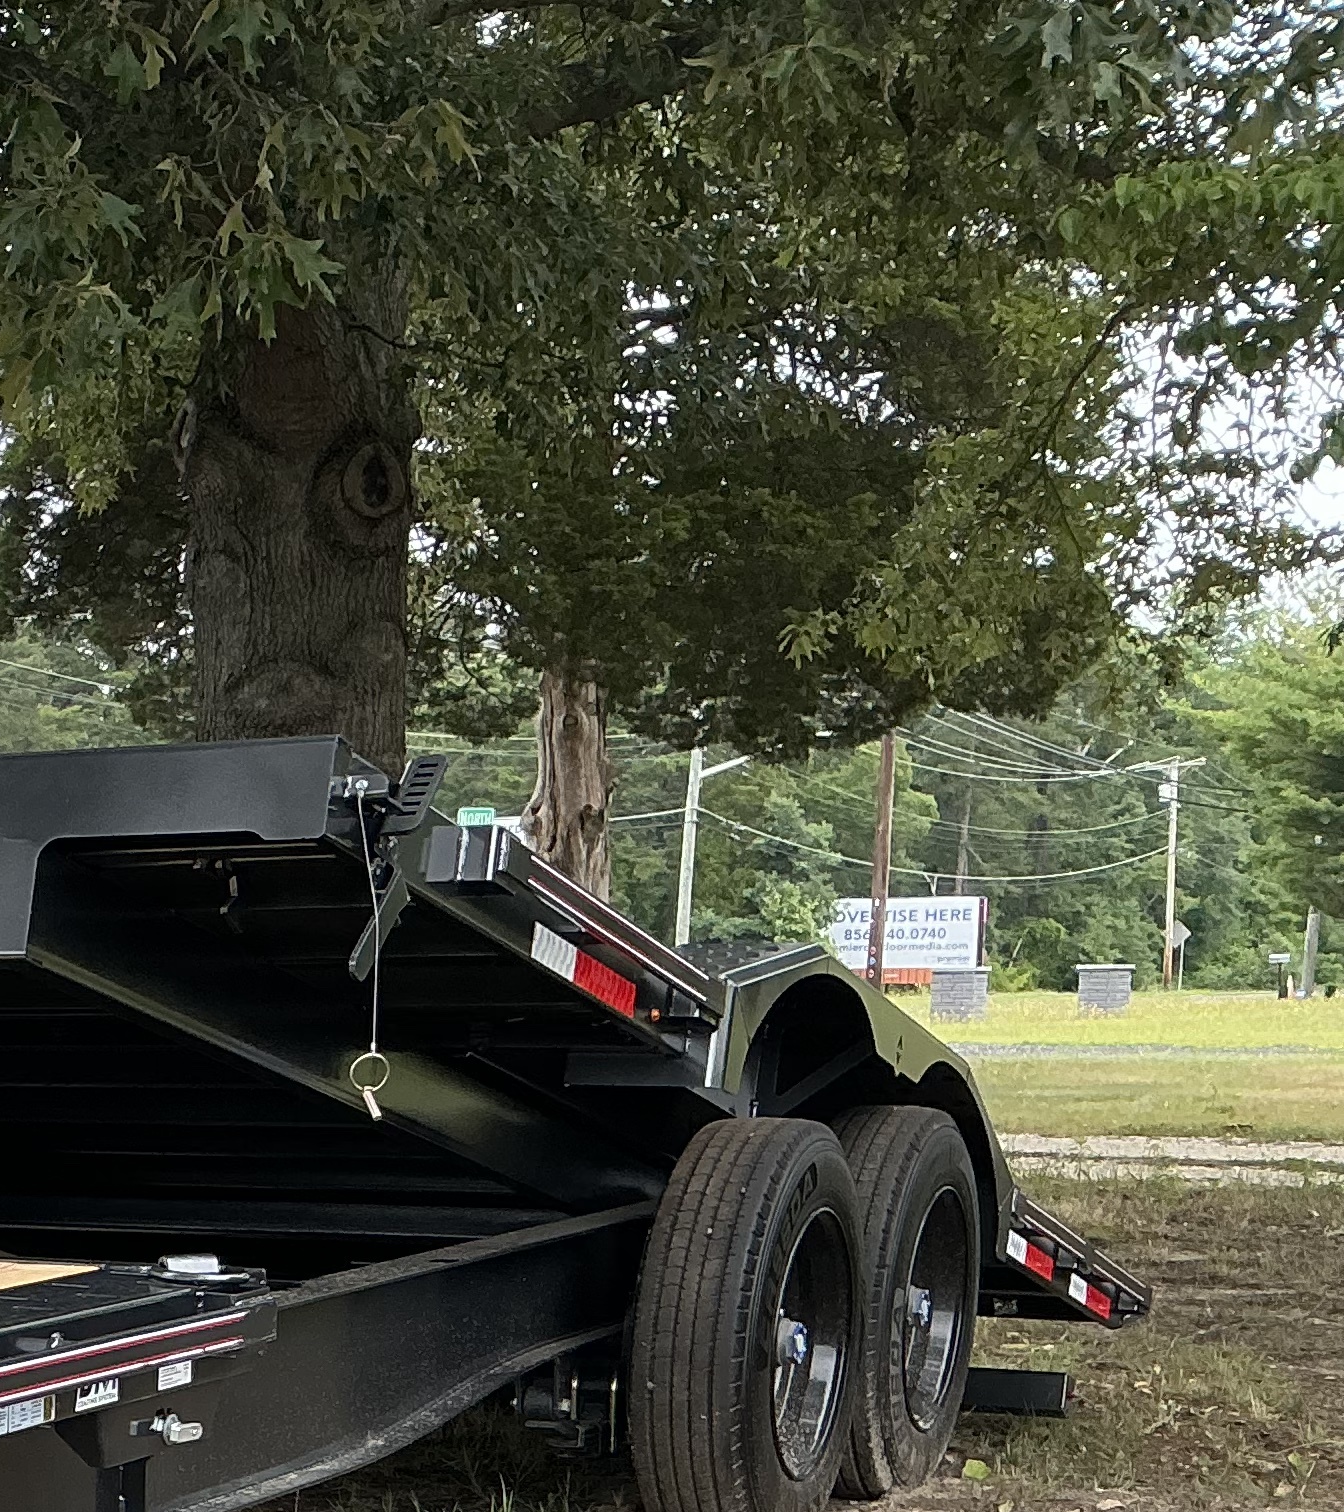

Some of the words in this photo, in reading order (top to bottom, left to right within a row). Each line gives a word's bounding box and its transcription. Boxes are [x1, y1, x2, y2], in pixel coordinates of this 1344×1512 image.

[461, 812, 493, 826] NORTH
[836, 909, 918, 923] DVETISE
[925, 908, 972, 922] HERE
[844, 928, 947, 940] 85640.0740
